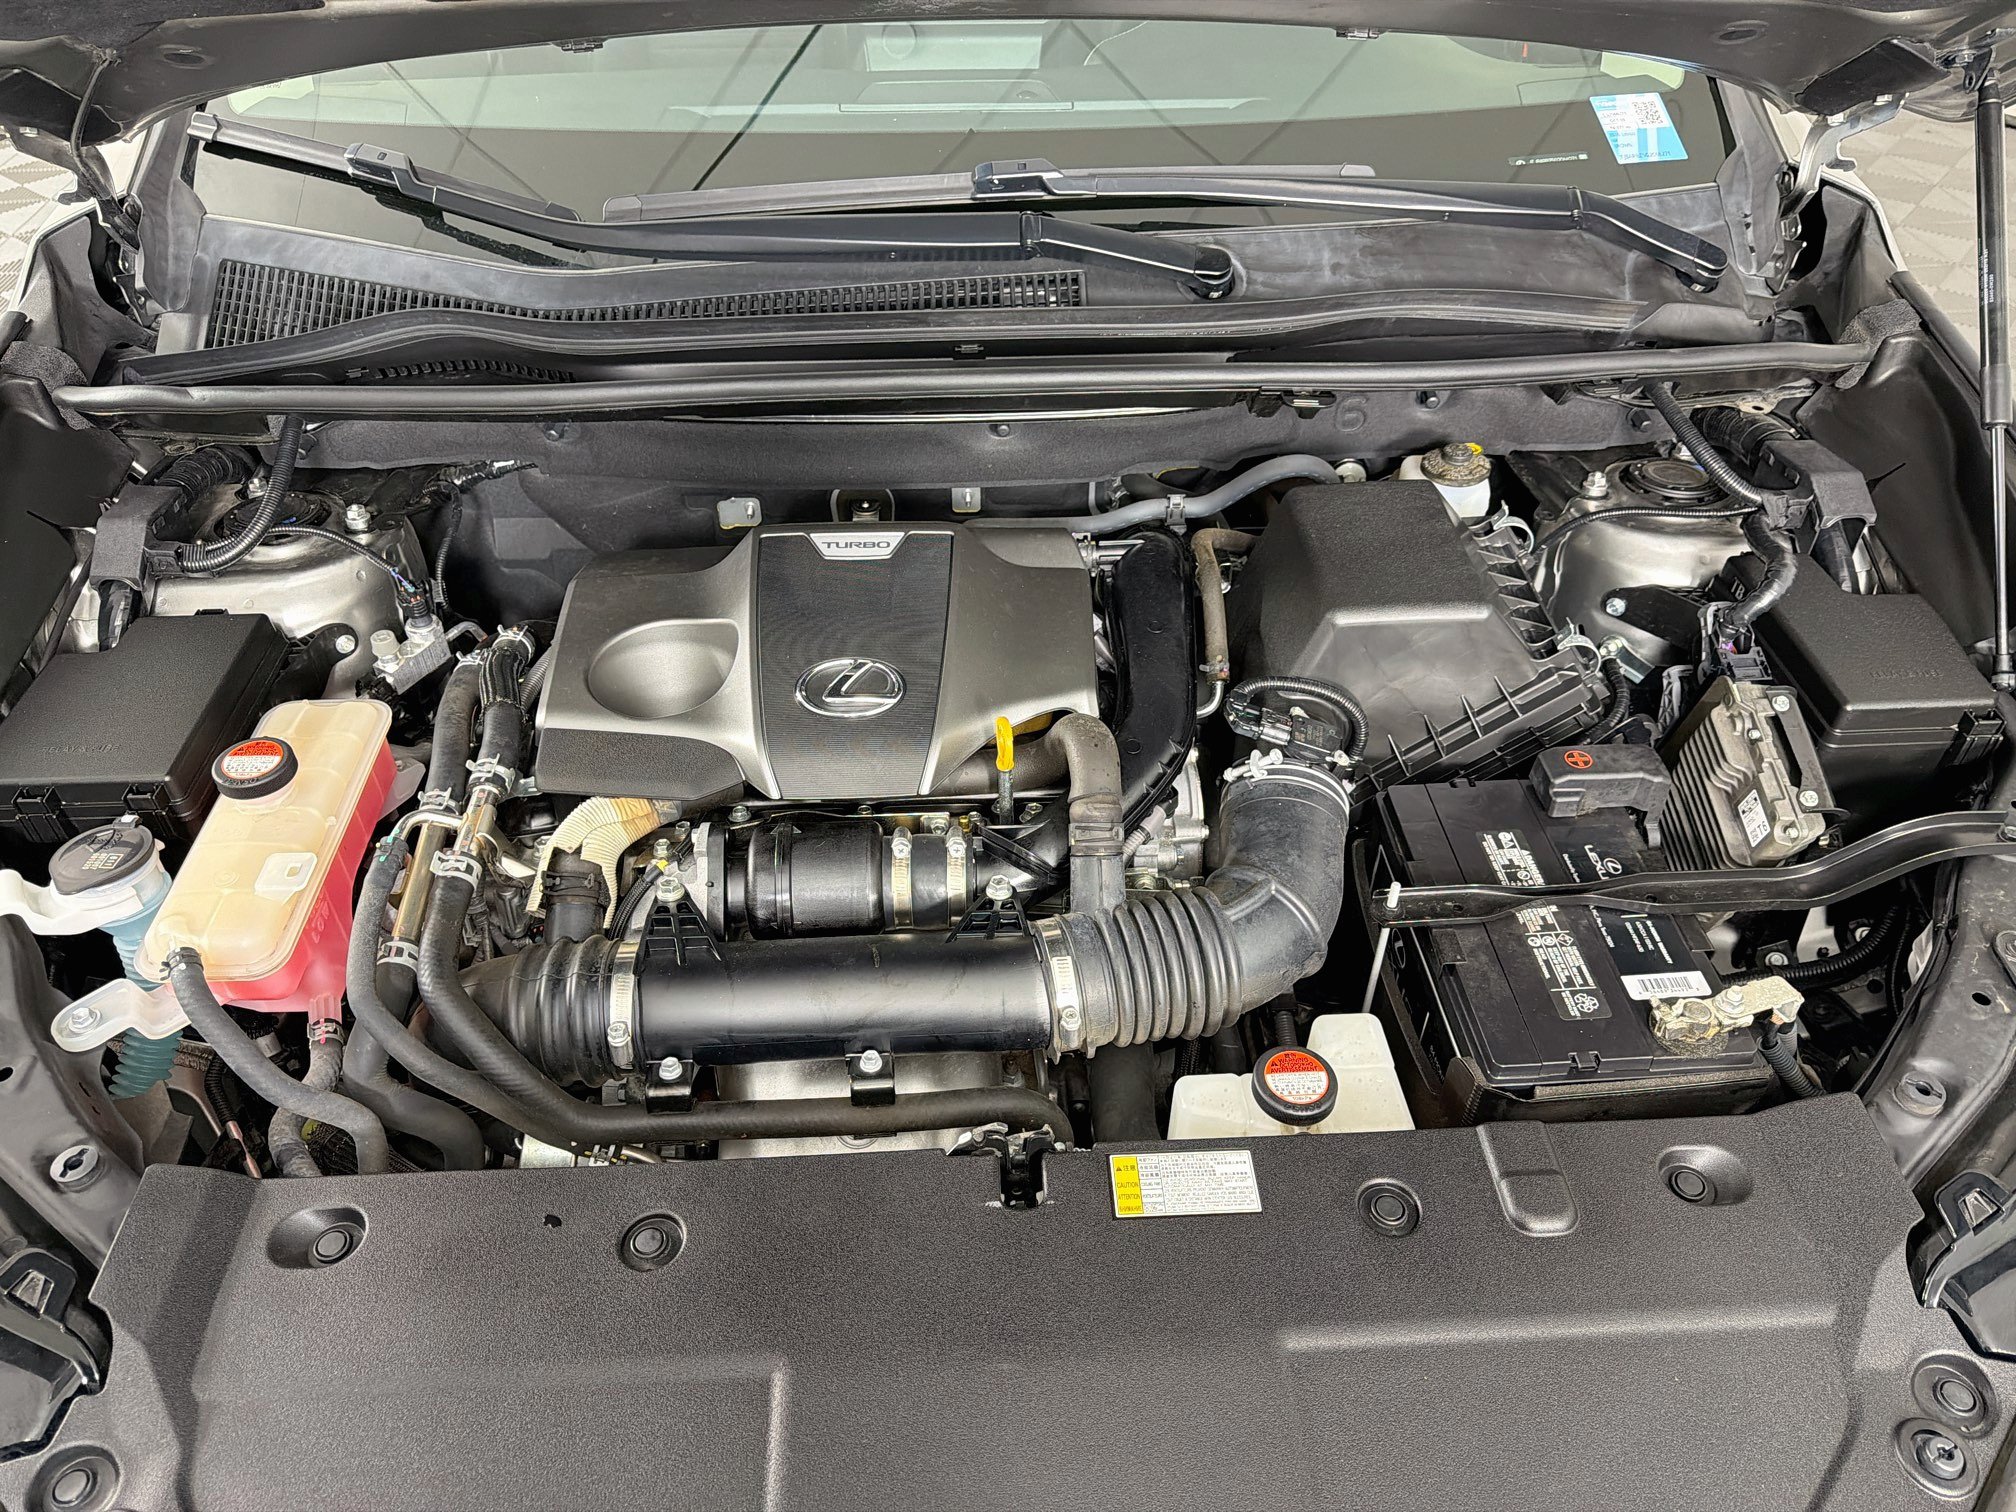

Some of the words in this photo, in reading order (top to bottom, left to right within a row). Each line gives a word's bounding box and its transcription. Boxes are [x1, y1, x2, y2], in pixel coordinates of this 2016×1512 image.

[821, 541, 891, 549] TURBO
[1757, 820, 1768, 836] T6
[1584, 844, 1609, 880] LEXU
